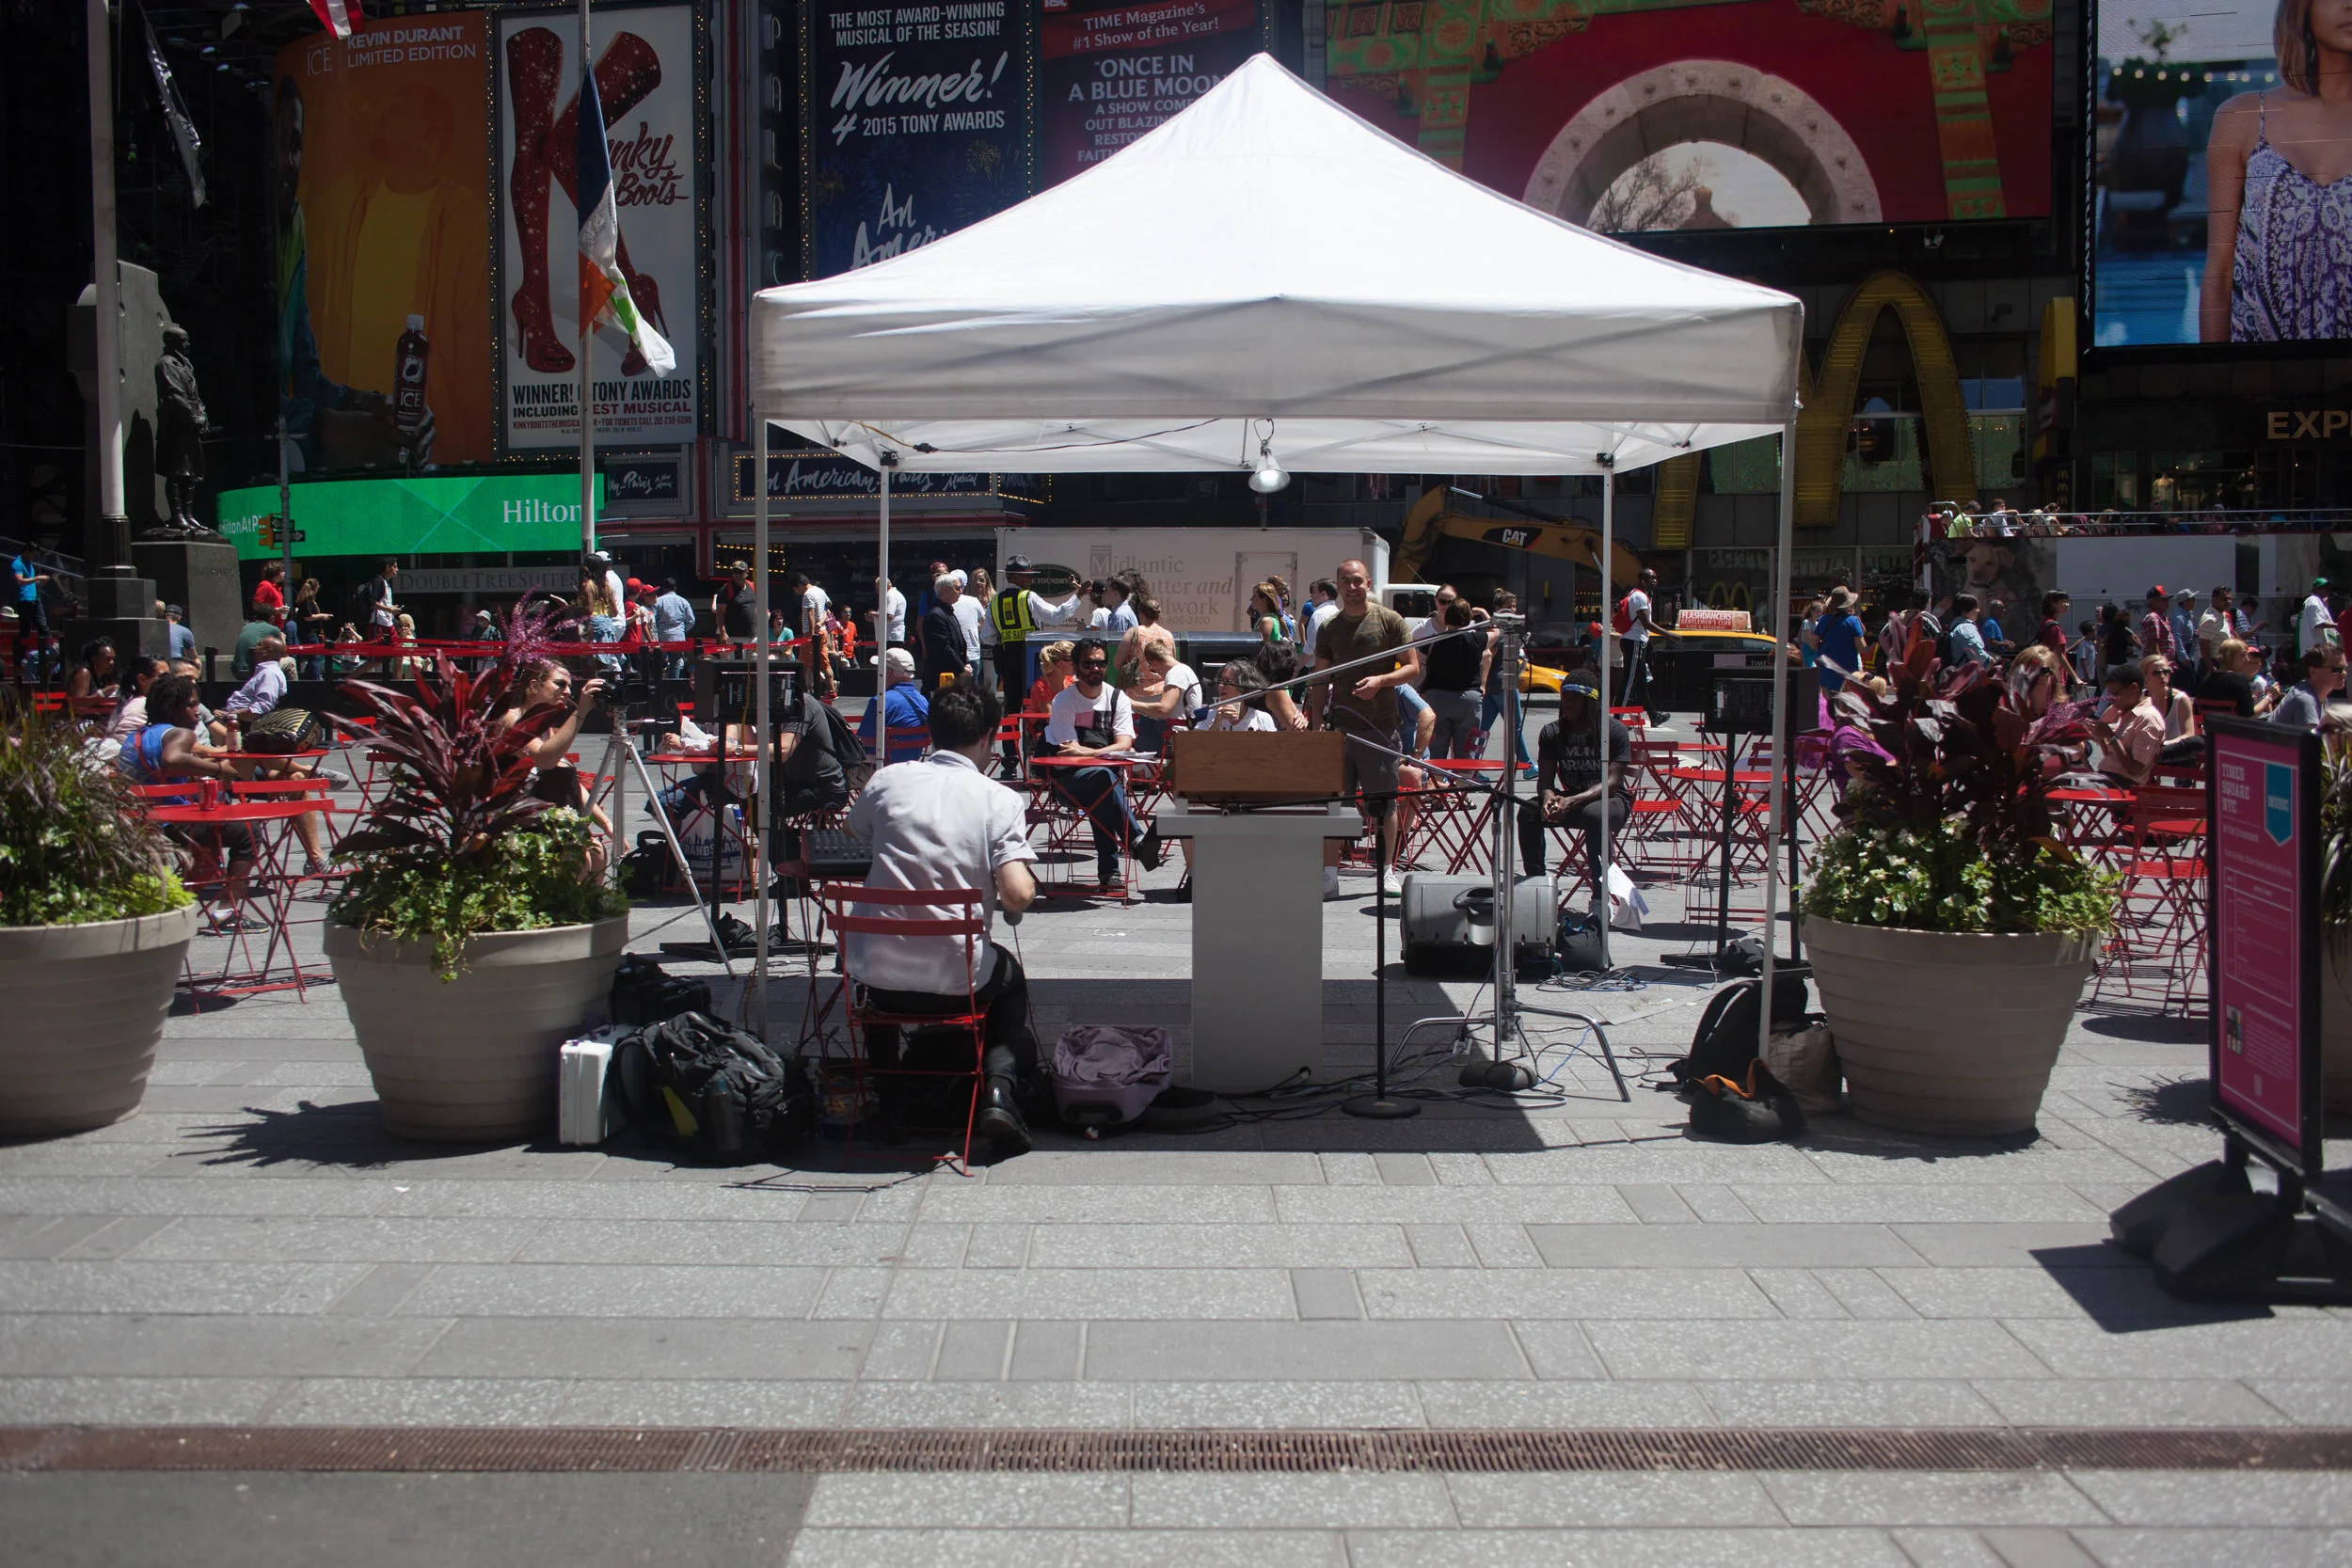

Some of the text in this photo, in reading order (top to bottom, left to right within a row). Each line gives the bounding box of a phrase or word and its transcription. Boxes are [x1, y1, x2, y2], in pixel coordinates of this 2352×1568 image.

[829, 1, 1005, 29] THE MOST AWARD-WINNING
[1084, 4, 1206, 31] TIME Magazine's
[347, 26, 464, 50] KEVIN DURANT
[836, 20, 1000, 47] MUSICAL OF THE SEASON!
[1073, 17, 1219, 51] #1 Show of the Year!
[307, 47, 333, 77] ICE
[347, 44, 476, 69] LIMITED EDITION
[1170, 55, 1195, 74] IN
[830, 51, 1009, 112] Winner!
[1068, 83, 1085, 102] A
[1090, 79, 1148, 101] BLUE
[1095, 98, 1196, 116] A SHOW COME
[832, 109, 1005, 147] 4 2015 TONY AWARDS
[1085, 115, 1169, 131] OUT BLAZIN
[615, 170, 691, 206] Boots
[877, 182, 916, 236] An
[400, 391, 421, 407] ICE
[514, 383, 573, 405] WINNER!
[631, 379, 691, 402] AWARDS
[513, 402, 691, 419] INCLUDING EST MUSICAL
[614, 417, 638, 426] TICKETS
[639, 416, 653, 426] CALL
[2267, 410, 2352, 440] EXP
[503, 499, 580, 524] Hilton
[1502, 528, 1528, 547] CAT
[1197, 577, 1233, 594] and
[1166, 616, 1211, 626] 806-3400
[1681, 611, 1732, 621] FLASHDANCERS
[1562, 759, 1601, 771] ARMAN
[2221, 763, 2245, 781] TIMES
[2221, 781, 2250, 800] SQUARE
[2221, 798, 2237, 814] NYC
[2266, 795, 2290, 813] MUSIC
